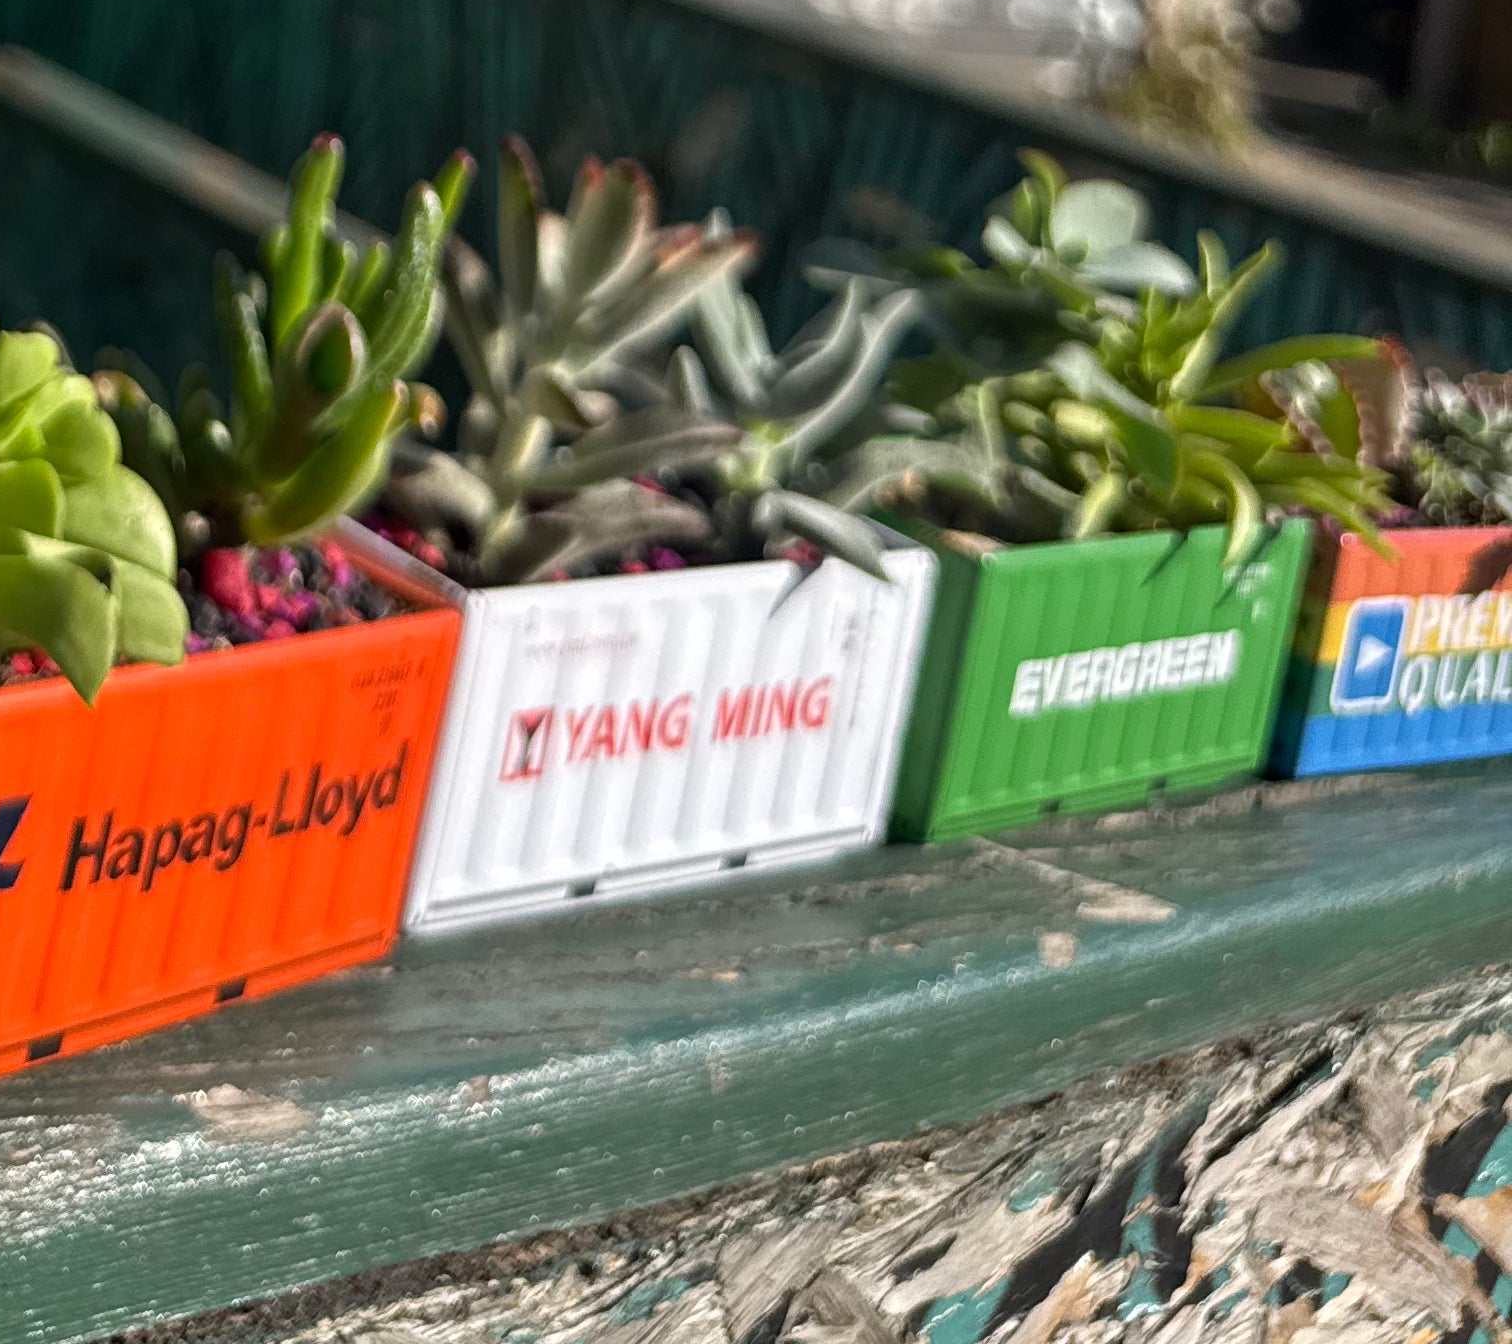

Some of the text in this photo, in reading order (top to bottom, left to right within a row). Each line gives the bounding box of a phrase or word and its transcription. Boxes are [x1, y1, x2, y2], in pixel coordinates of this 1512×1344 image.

[1008, 628, 1242, 718] EVERGREEN
[565, 675, 834, 766] YANG MING
[60, 740, 411, 894] Hapag-Lloyd
